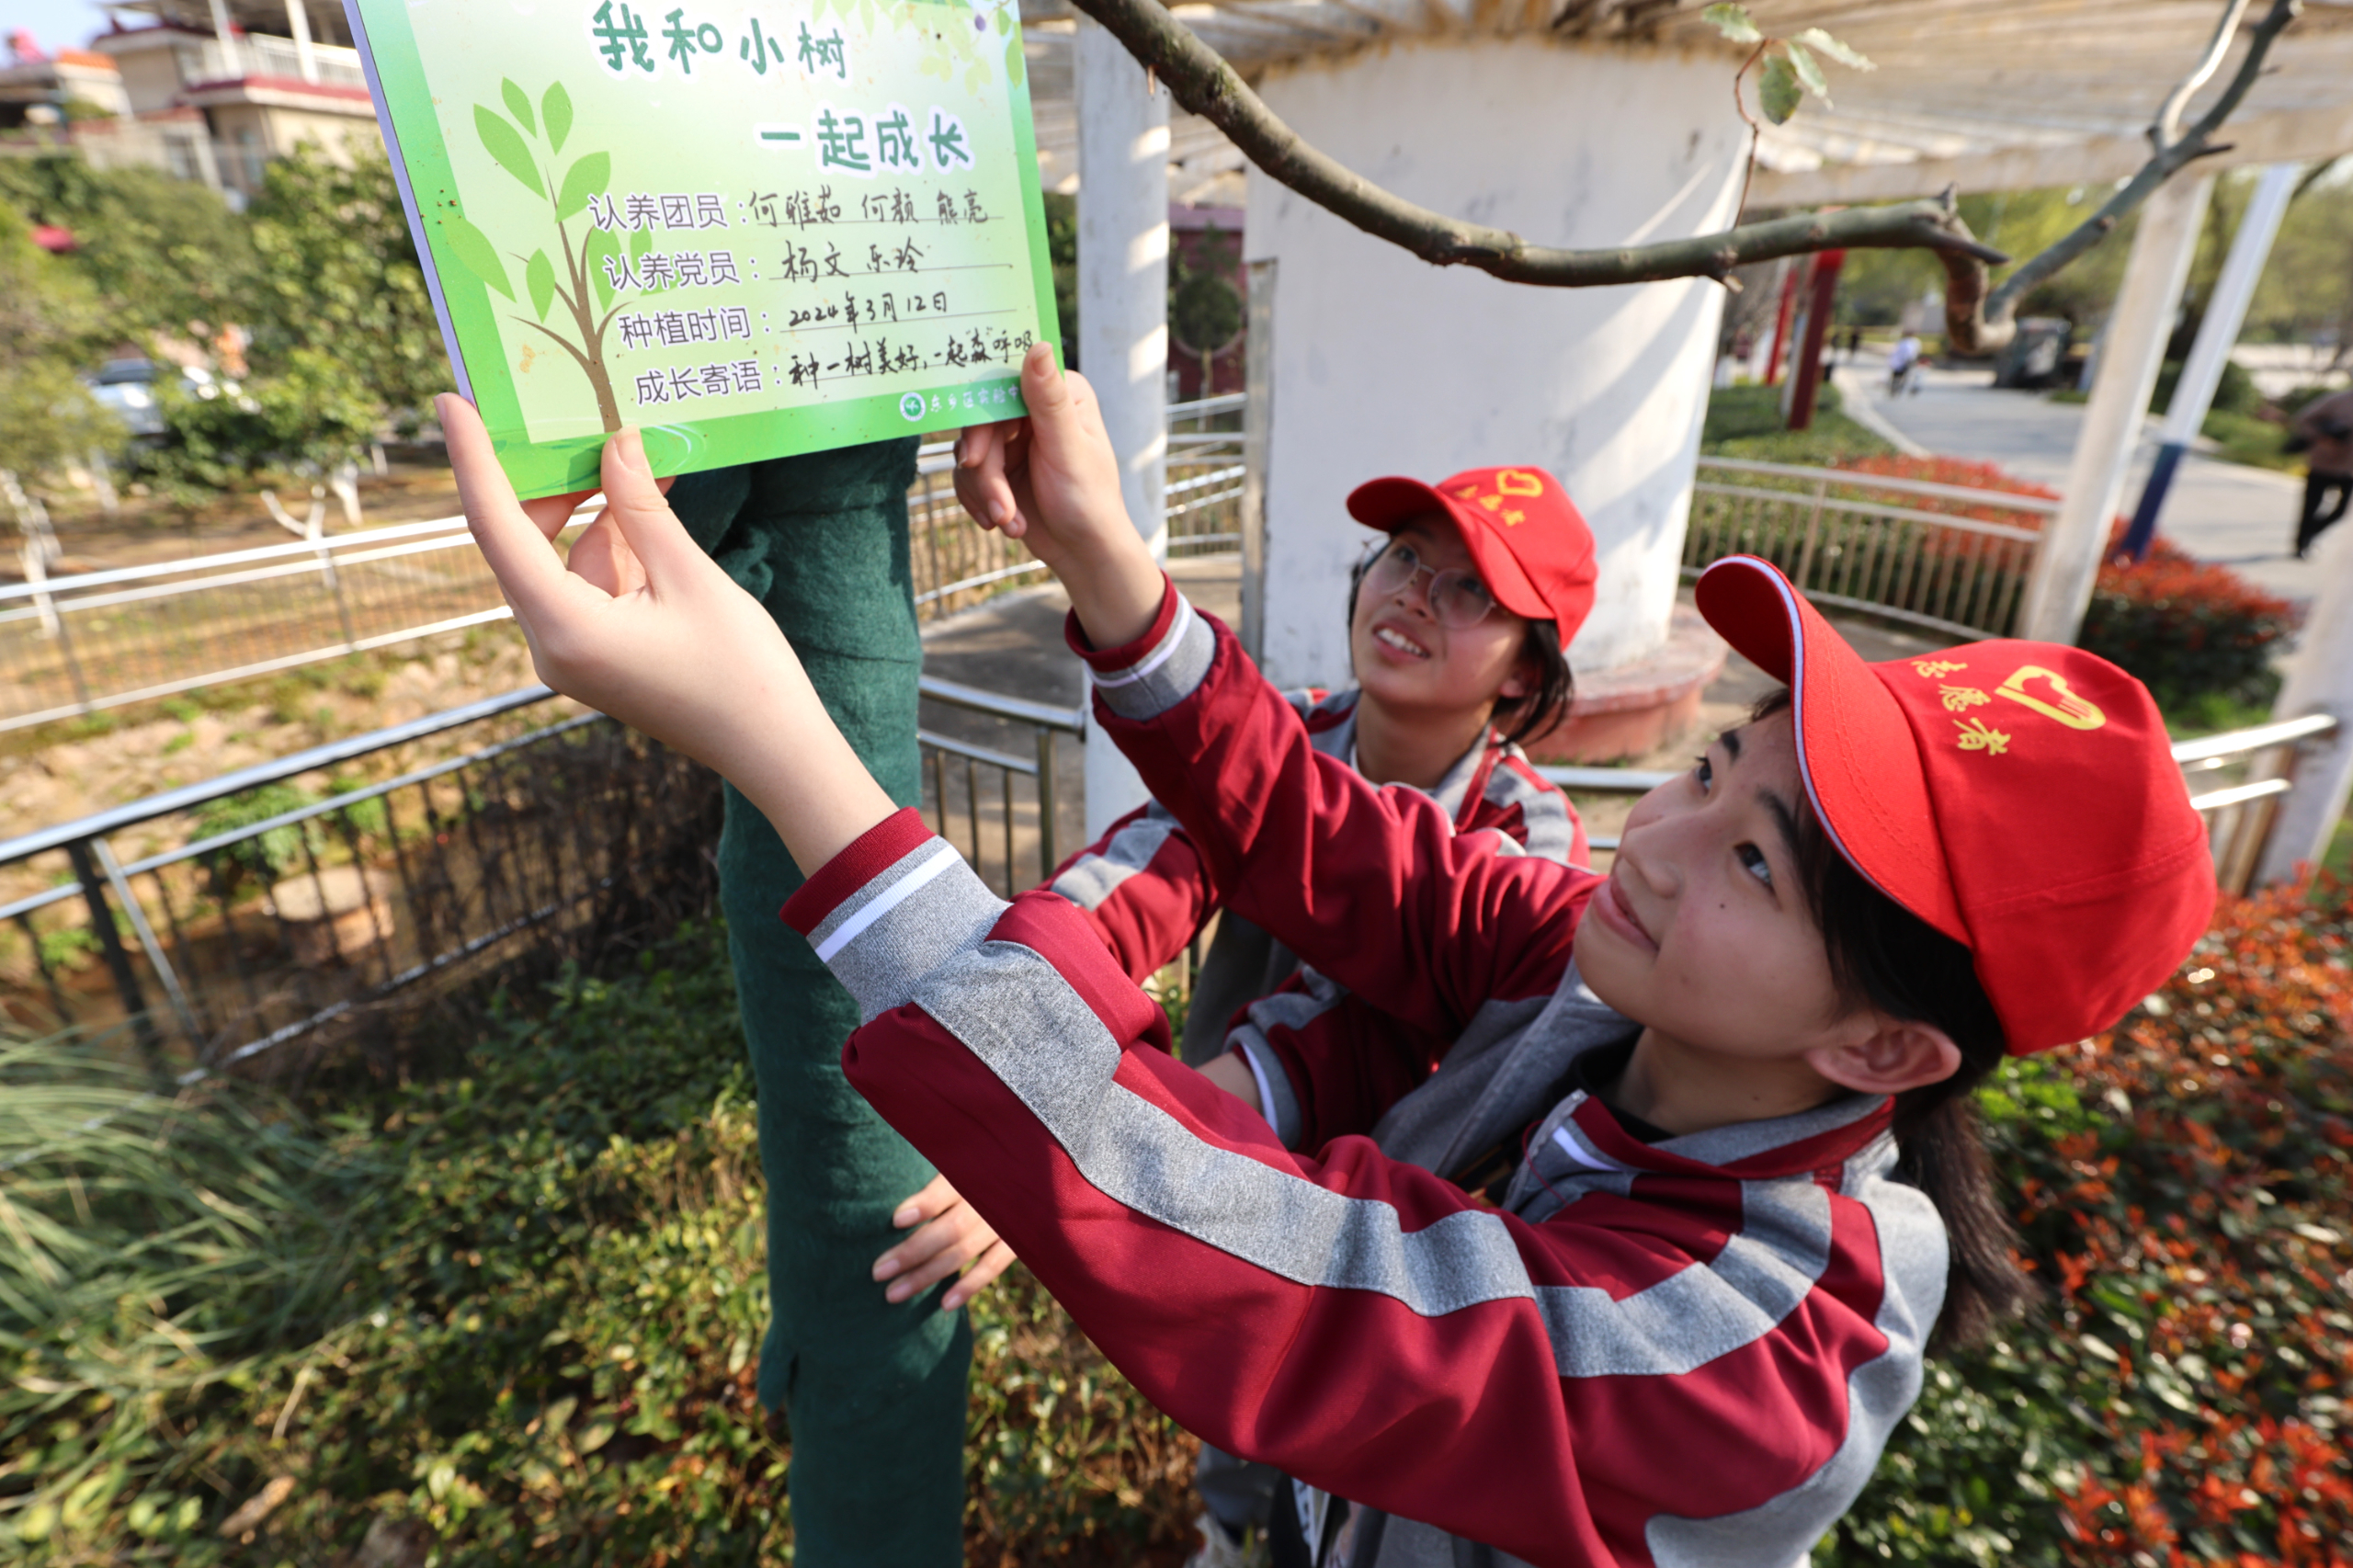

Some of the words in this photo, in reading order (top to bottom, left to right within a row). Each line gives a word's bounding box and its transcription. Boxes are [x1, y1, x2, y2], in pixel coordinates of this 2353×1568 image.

[593, 0, 846, 80] 我和小树
[760, 109, 970, 172] 一起成长
[590, 194, 748, 230] 认养团员:
[604, 253, 759, 290] 认养党员:
[618, 307, 770, 349] 种植时间:
[789, 290, 948, 334] 2024年3月12日
[636, 361, 782, 406] 成长寄语:
[1910, 660, 2012, 756] 志愿者
